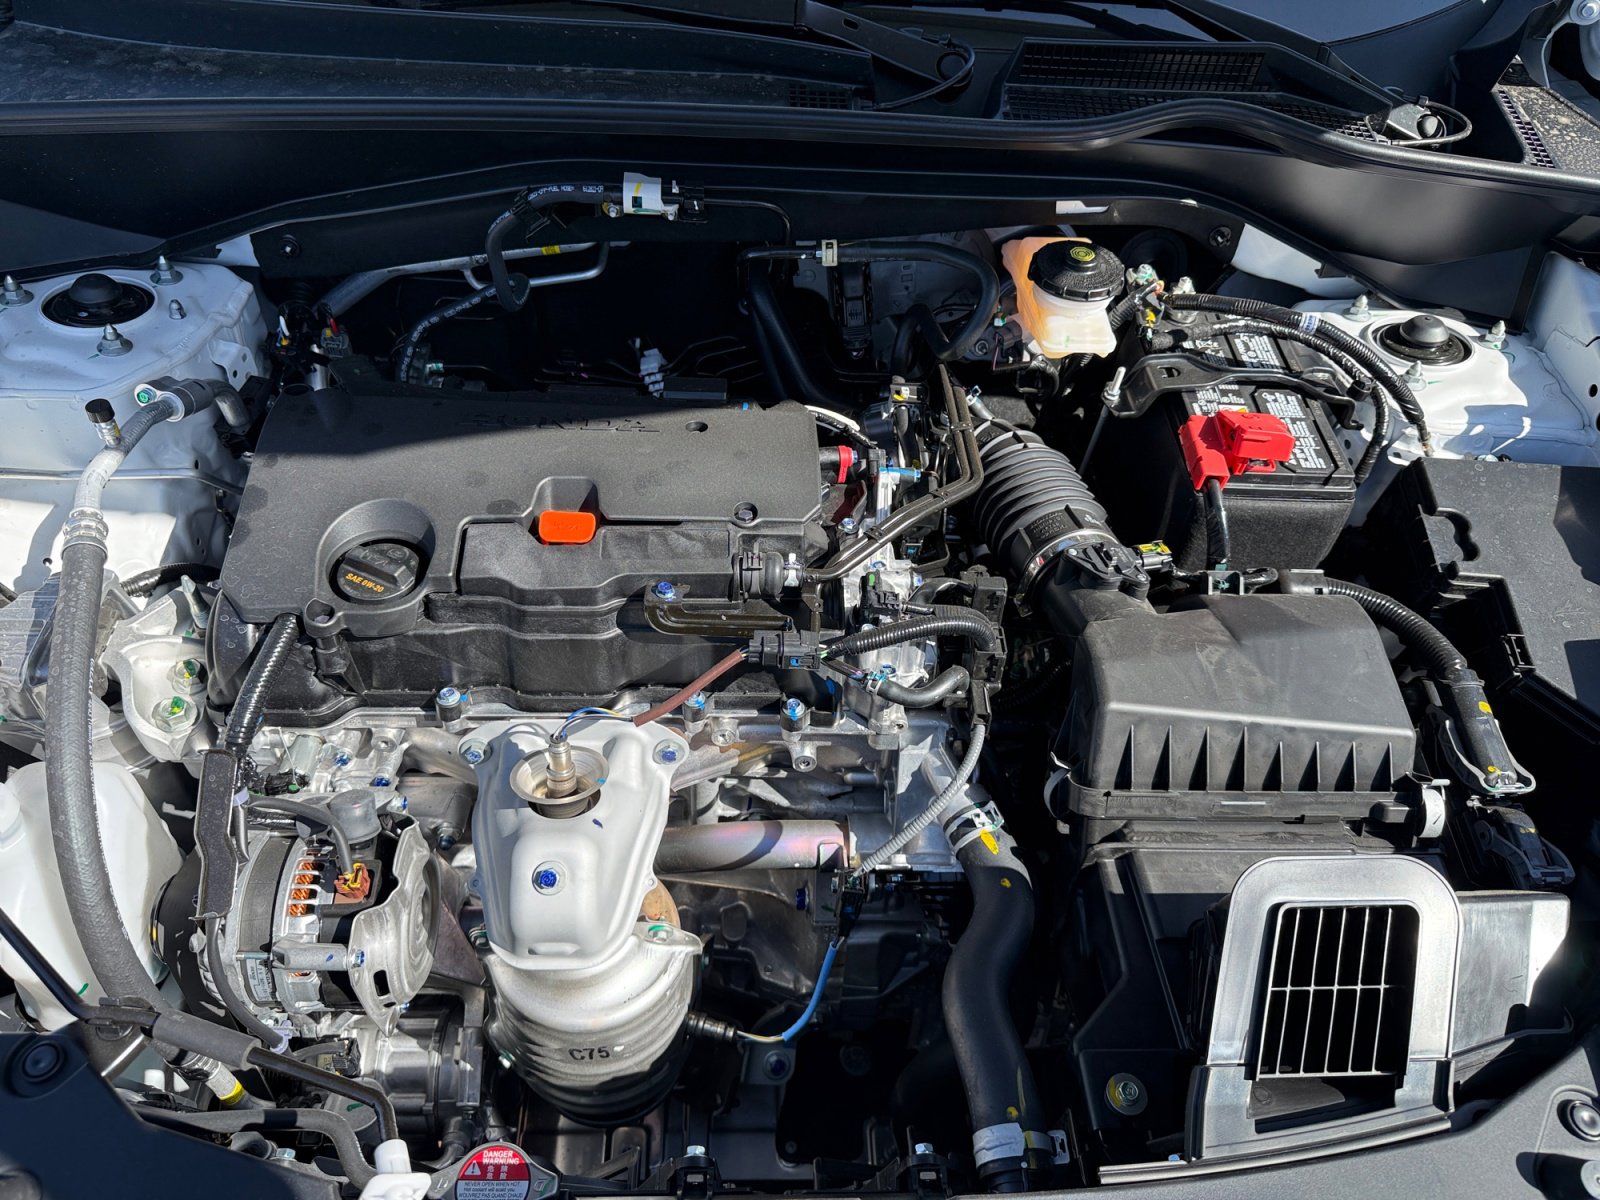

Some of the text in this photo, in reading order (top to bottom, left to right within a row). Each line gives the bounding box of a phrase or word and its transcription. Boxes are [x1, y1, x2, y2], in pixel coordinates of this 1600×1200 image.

[345, 573, 385, 593] SAE 0W-20
[568, 1046, 610, 1061] C75
[483, 1150, 513, 1158] DANGER
